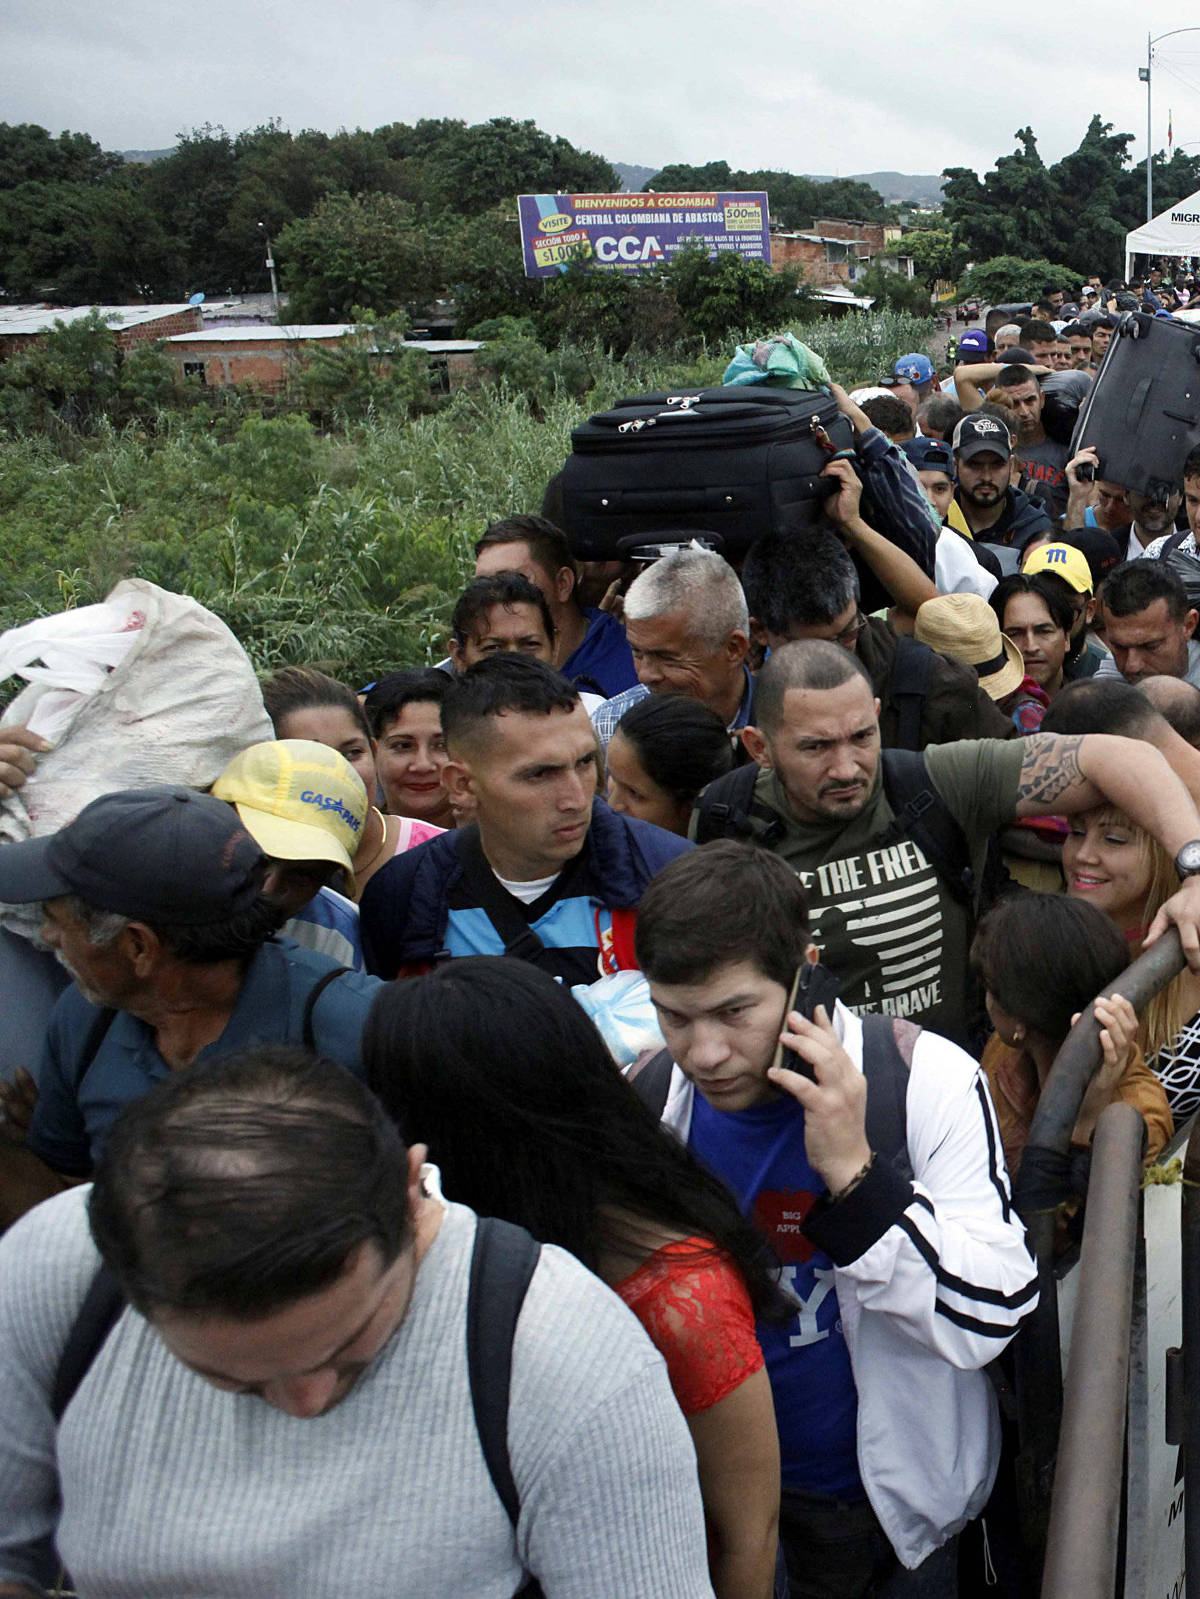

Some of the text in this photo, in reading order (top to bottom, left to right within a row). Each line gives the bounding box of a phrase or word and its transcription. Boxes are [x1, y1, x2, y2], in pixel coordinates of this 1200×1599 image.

[575, 197, 715, 208] BIENVENIDOS A COLOMBIA!
[541, 216, 569, 229] VISITE
[575, 214, 613, 225] CENTRAL
[615, 213, 671, 224] COLOMBIANA
[672, 213, 684, 223] DE
[685, 212, 724, 223] ABASTOS
[563, 233, 580, 243] TODO
[581, 232, 587, 240] A
[595, 236, 665, 261] CCA
[300, 790, 336, 809] GAS
[816, 856, 867, 897] THE
[881, 979, 943, 1019] BRAVE
